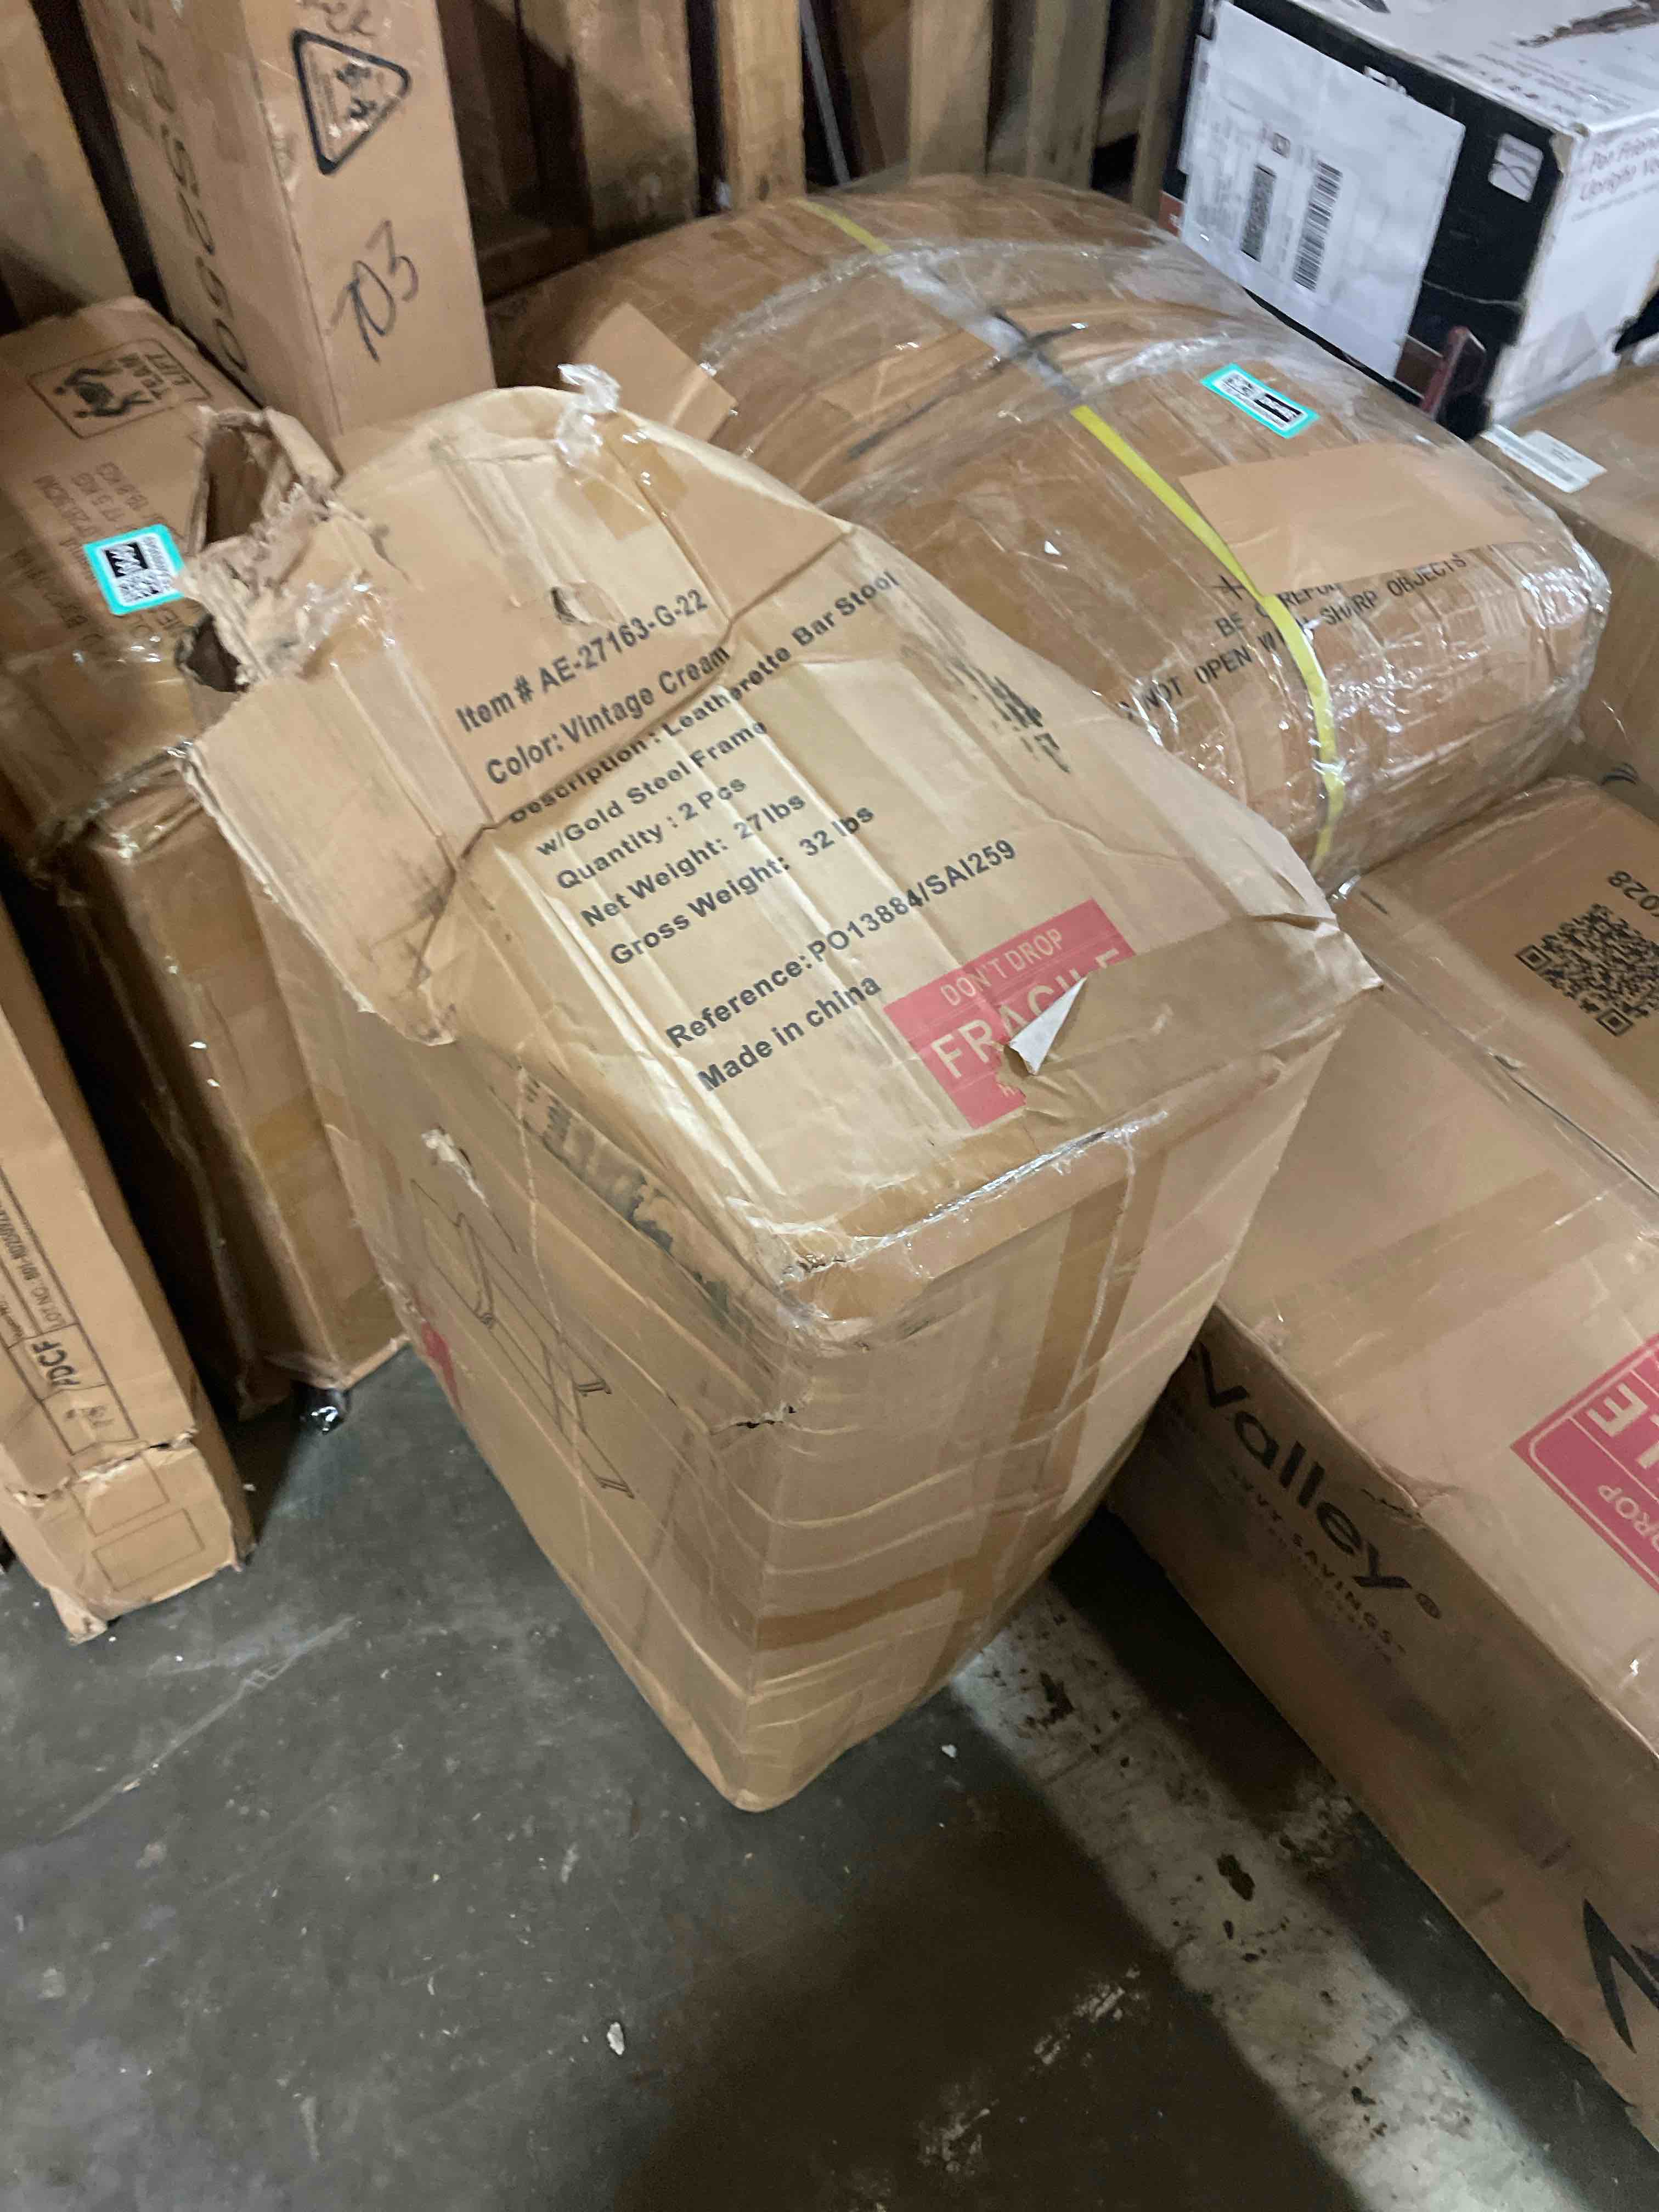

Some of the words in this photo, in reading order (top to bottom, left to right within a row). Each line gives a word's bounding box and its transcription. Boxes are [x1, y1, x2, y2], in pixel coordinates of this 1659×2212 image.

[454, 691, 517, 733] Item
[538, 588, 709, 694] AE-27163-G-22
[662, 646, 792, 737] Leatherette
[791, 610, 836, 646] Bar
[834, 571, 901, 616] Stool
[1194, 645, 1253, 685] OPEN
[1386, 552, 1468, 599] OBJECTS
[1216, 612, 1245, 638] BE
[486, 732, 565, 785] Color:
[560, 686, 655, 744] Vintage
[658, 646, 731, 696] Cream
[535, 799, 625, 856] w/Gold
[626, 760, 692, 805] Steel
[689, 721, 768, 769] Frame
[580, 892, 631, 928] Net
[626, 837, 729, 900] Weight:
[610, 913, 691, 964] Gross
[687, 856, 791, 918] Weight:
[798, 829, 835, 857] 32
[831, 806, 875, 837] lbs
[940, 960, 1009, 1006] DON'T
[1005, 928, 1063, 972] DROP
[697, 1040, 774, 1092] Made
[770, 1017, 805, 1047] in
[805, 977, 883, 1029] china
